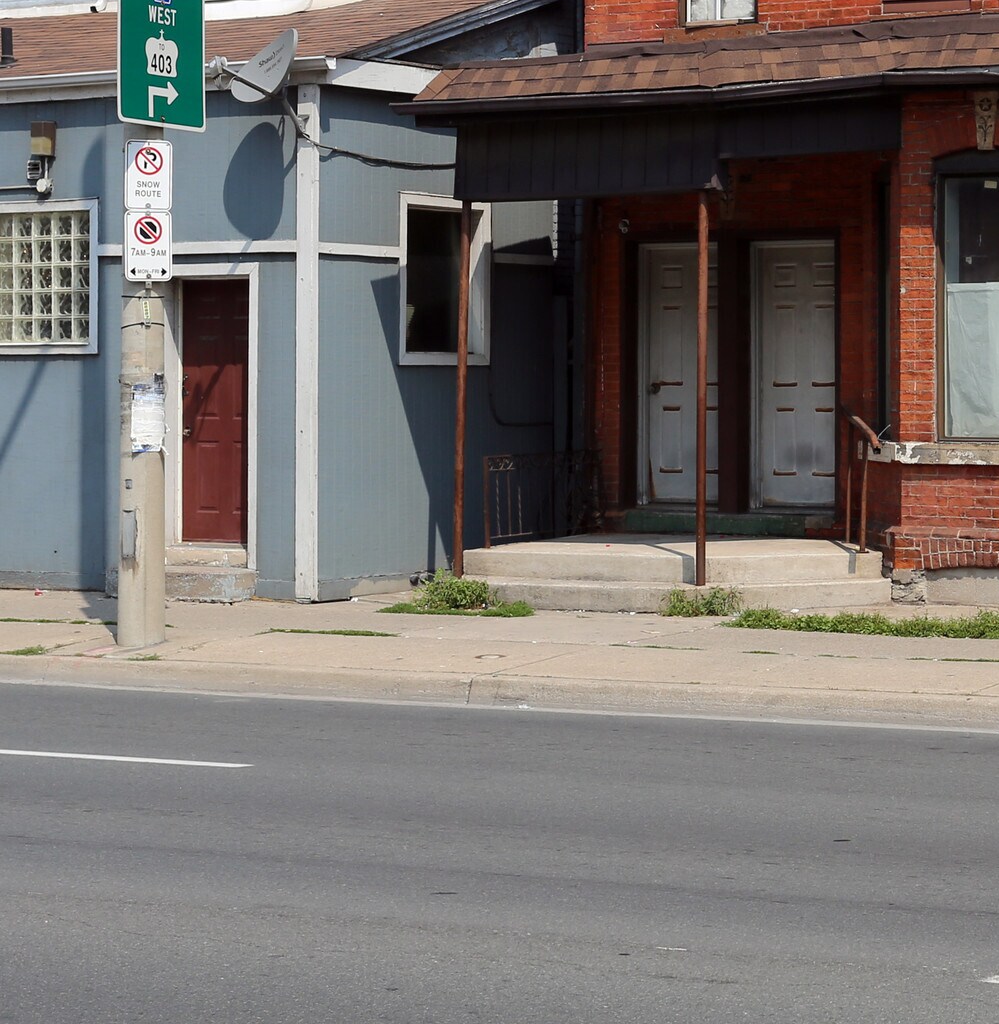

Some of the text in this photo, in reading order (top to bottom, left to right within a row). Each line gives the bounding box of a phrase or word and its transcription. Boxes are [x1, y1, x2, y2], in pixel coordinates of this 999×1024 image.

[148, 4, 177, 27] WEST
[159, 43, 166, 52] TO
[151, 53, 172, 75] 403
[136, 180, 161, 189] SNOW
[135, 189, 162, 198] ROUTE
[130, 247, 167, 257] 7AM-9AM
